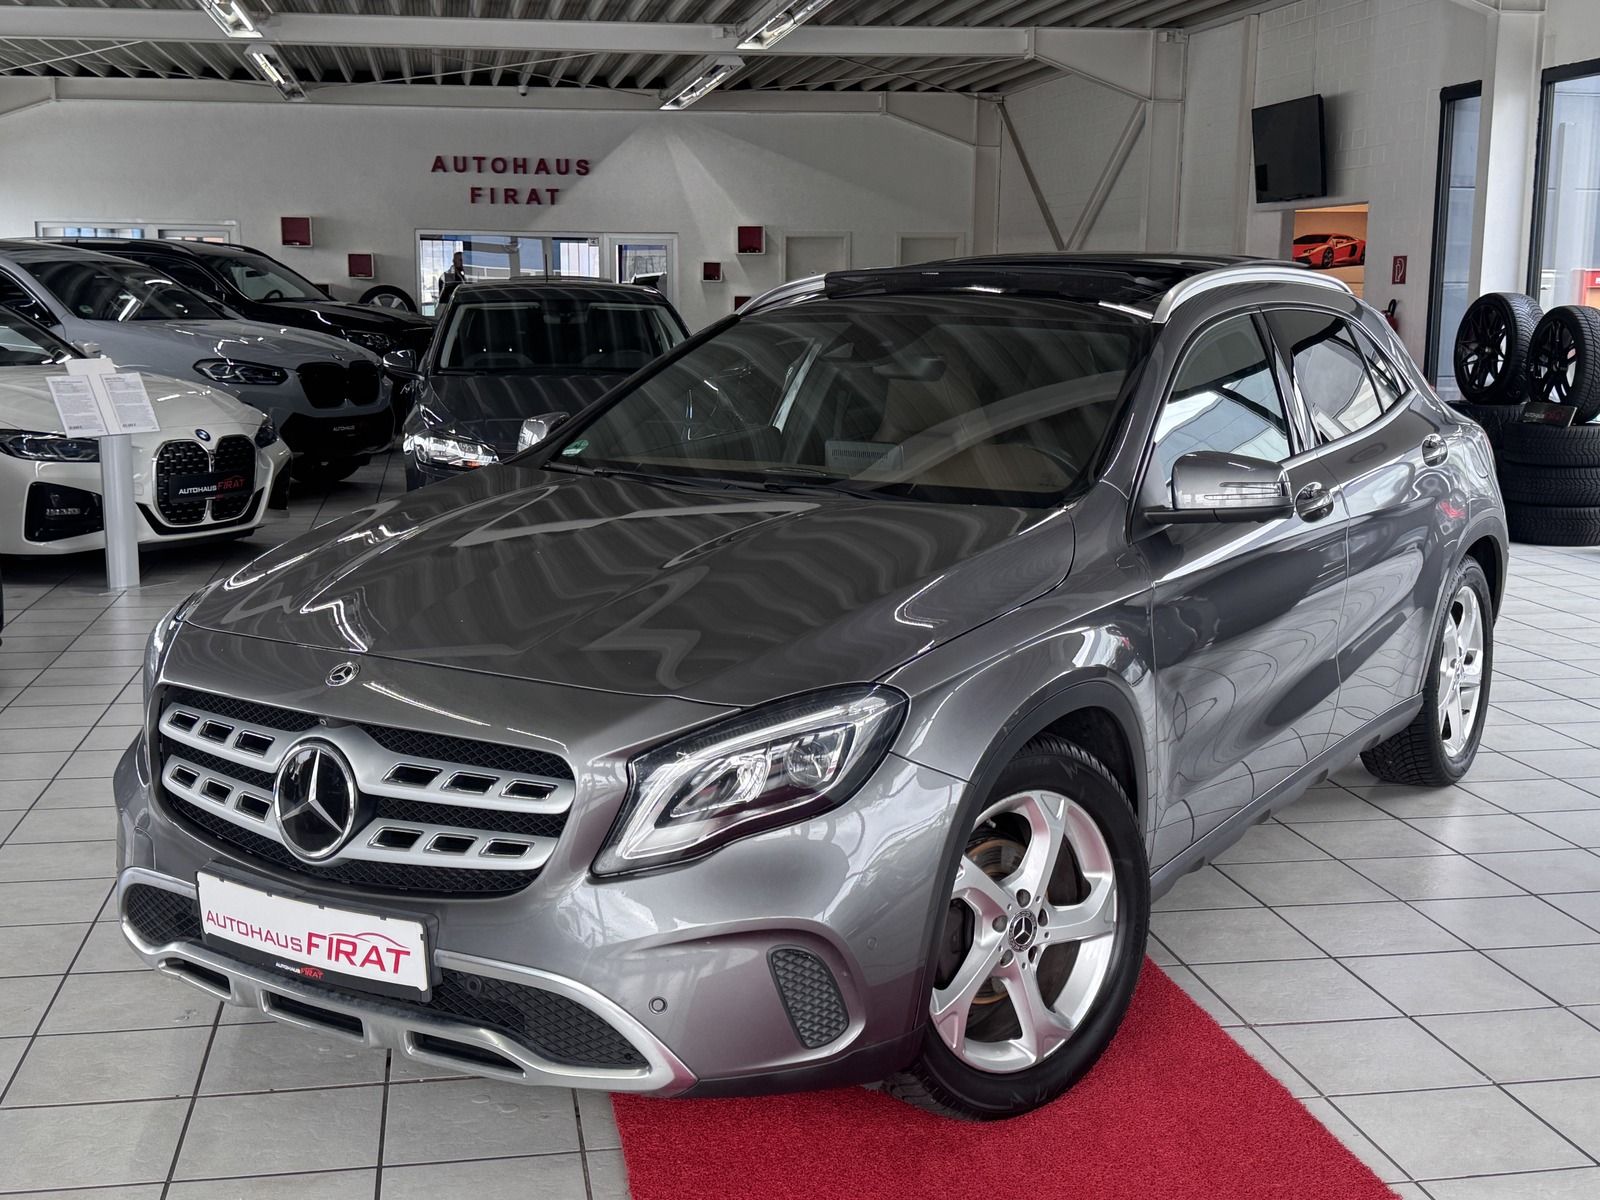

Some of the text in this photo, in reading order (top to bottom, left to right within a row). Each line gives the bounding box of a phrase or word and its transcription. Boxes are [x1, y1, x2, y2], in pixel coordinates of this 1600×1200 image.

[431, 155, 590, 176] AUTOHAUS
[470, 187, 560, 206] FIRAT
[179, 479, 246, 495] AUTOHAUS FIRAT
[206, 910, 411, 974] AUTOHAUS FIRAT
